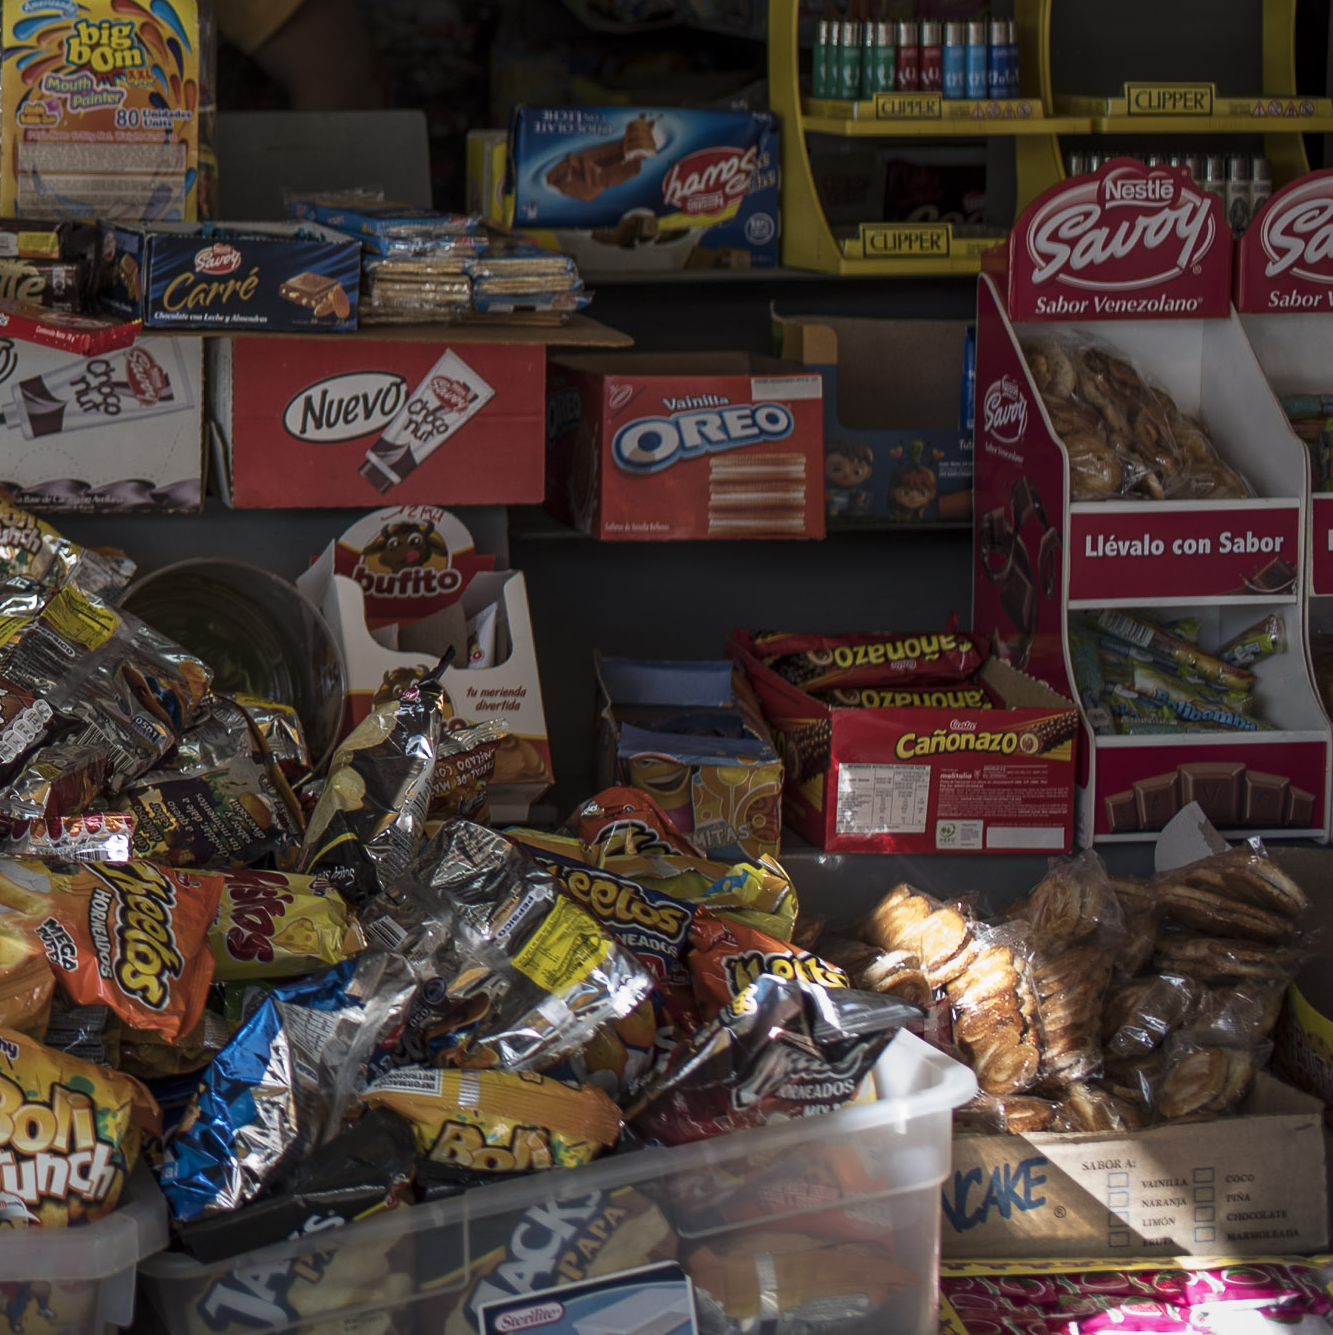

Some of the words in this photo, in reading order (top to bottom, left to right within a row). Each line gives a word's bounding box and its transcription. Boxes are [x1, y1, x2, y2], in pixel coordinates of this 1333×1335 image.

[881, 100, 936, 115] CLIPPER
[1134, 90, 1207, 110] CLIPPER
[1105, 179, 1174, 201] Nestlé
[870, 231, 946, 251] CLIPPER
[1032, 198, 1211, 284] Savoy
[164, 267, 259, 311] Carré
[1035, 297, 1088, 314] Sabor
[1094, 297, 1199, 312] Venezolano
[663, 395, 728, 411] Vainilla
[618, 404, 791, 470] OREO
[1086, 532, 1164, 557] Llévalo
[1172, 534, 1211, 555] con
[1219, 531, 1283, 554] Sabor
[353, 569, 460, 595] bufito
[480, 687, 526, 698] merienda
[476, 699, 520, 711] divertida
[896, 728, 1017, 759] Cañonazo
[1082, 1160, 1122, 1171] SABOR
[1141, 1178, 1188, 1188] VAINILLA
[1226, 1174, 1254, 1184] COCO
[1141, 1197, 1187, 1208] NARANJA
[1226, 1192, 1250, 1203] PIÑA
[1142, 1216, 1175, 1227] LIMÓN
[1227, 1209, 1287, 1221] CHOCOLATE
[1227, 1229, 1299, 1241] MARMOLEADA
